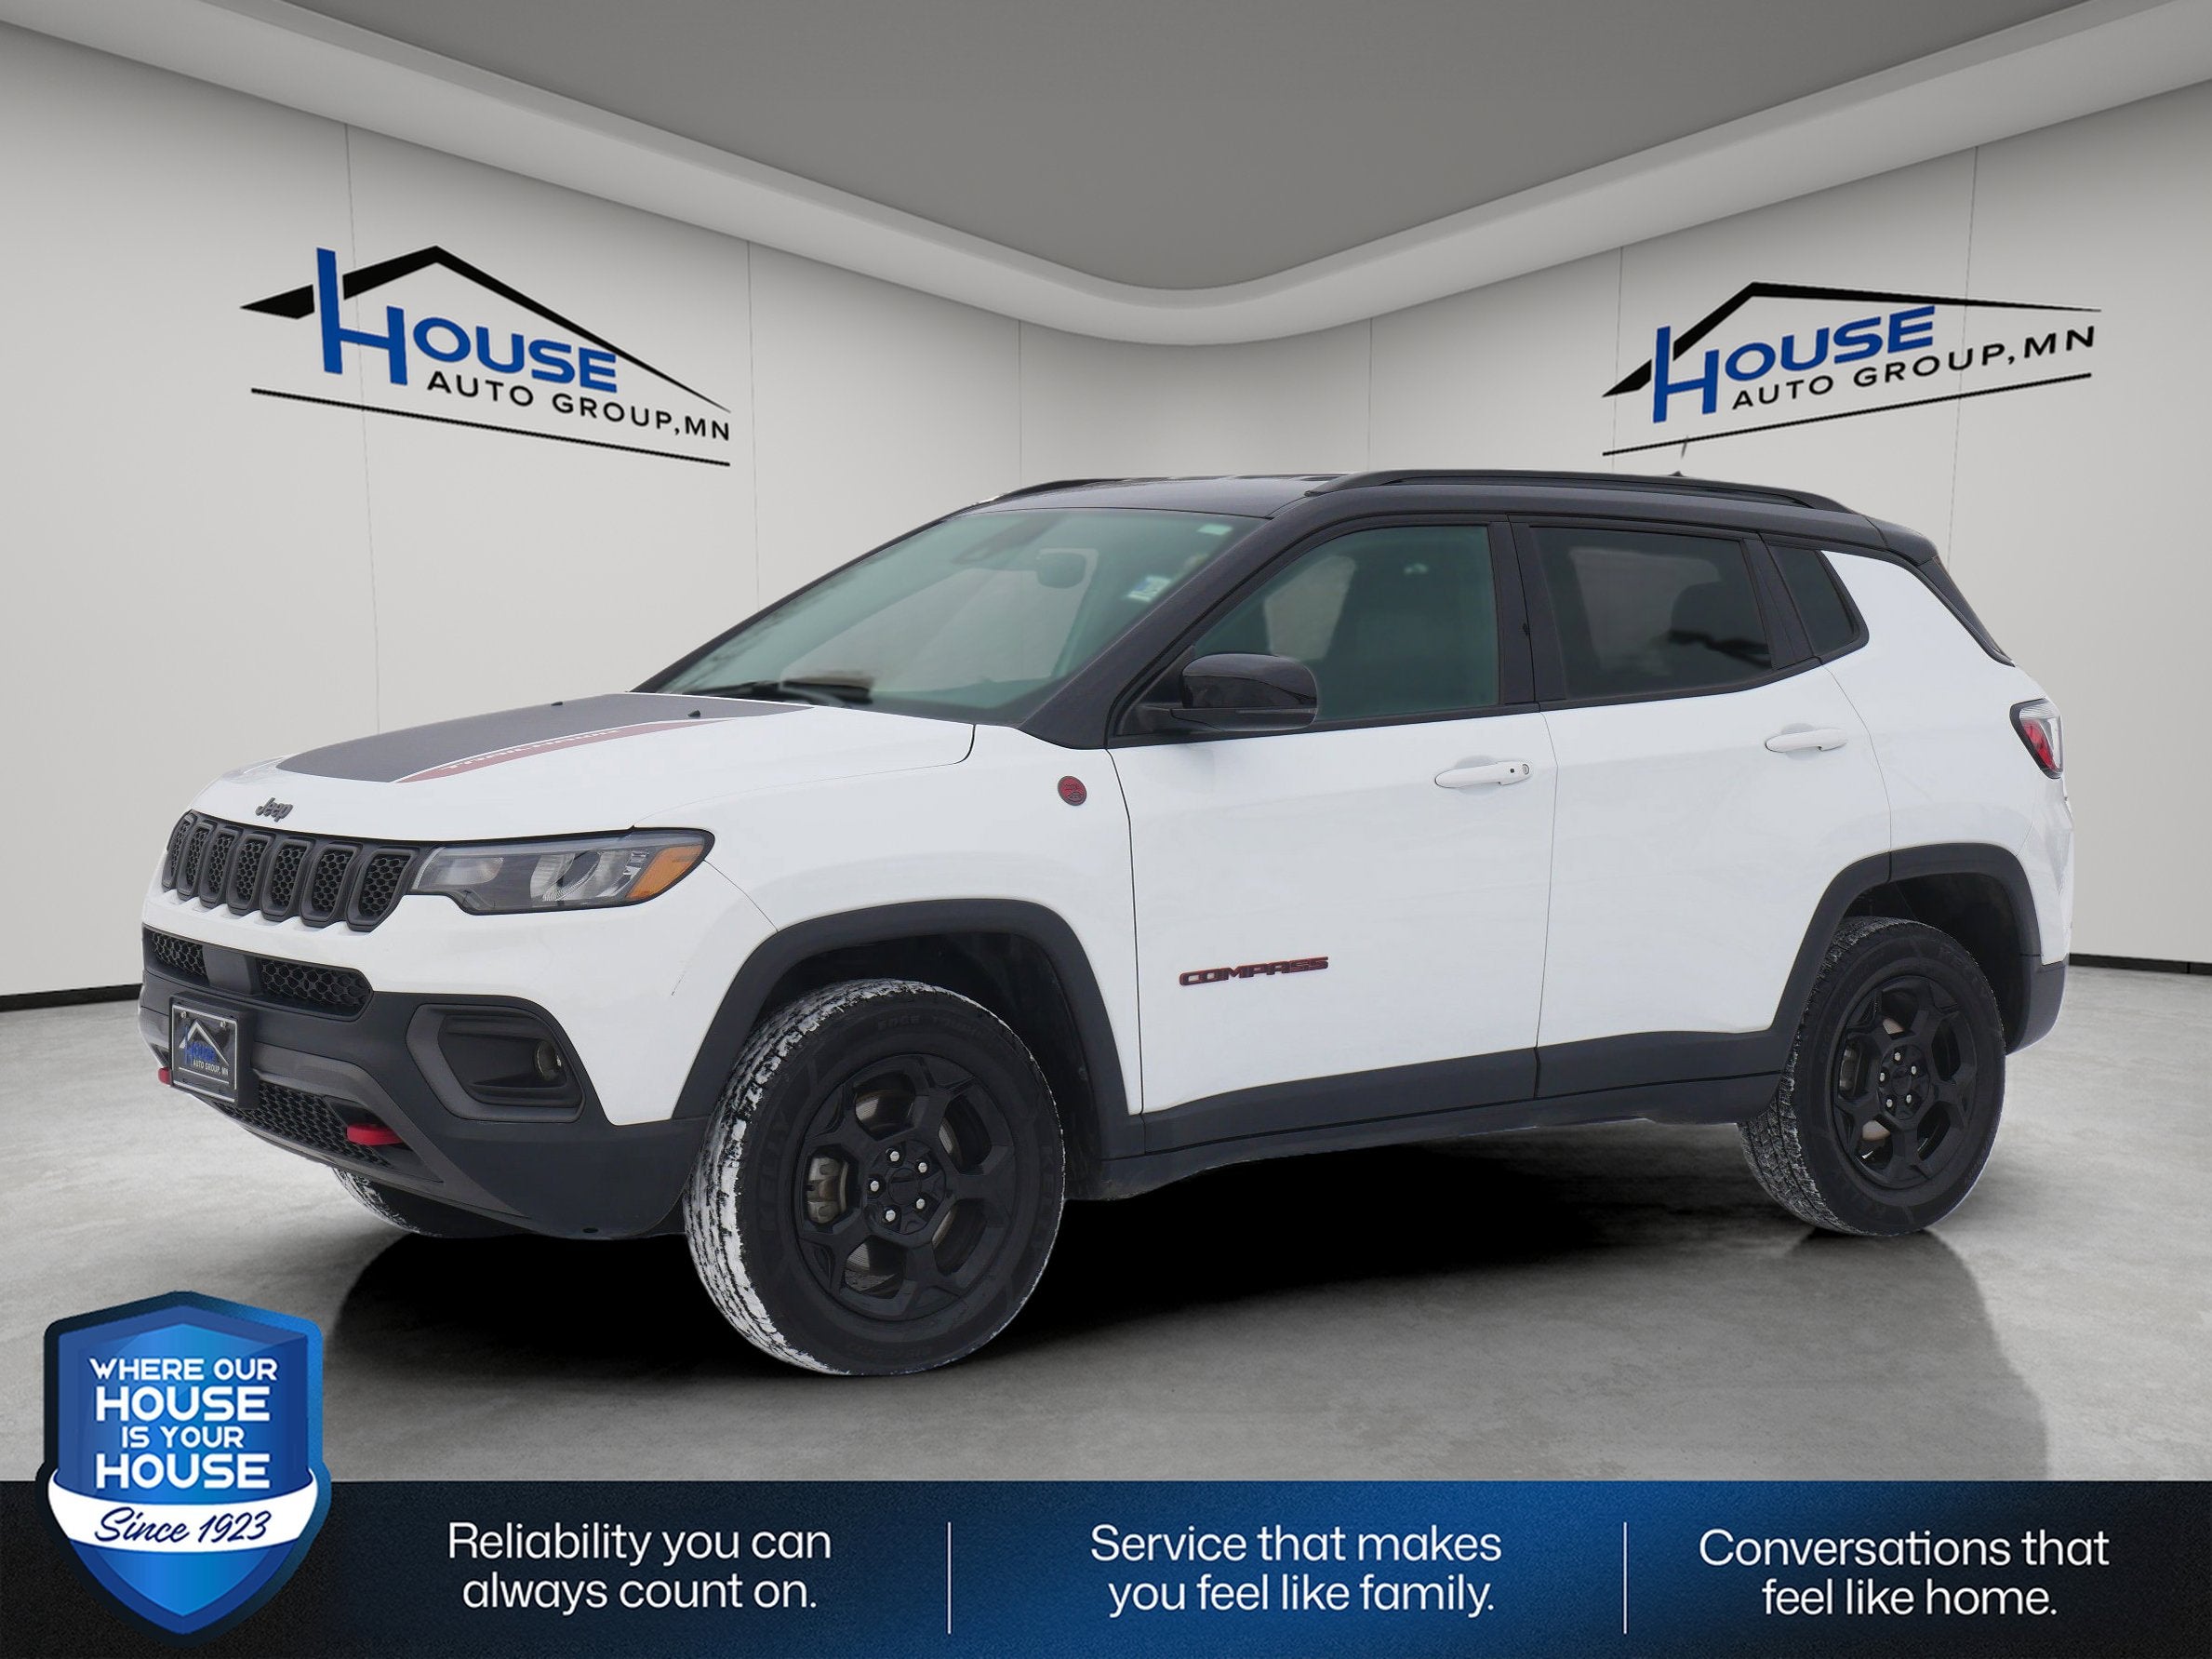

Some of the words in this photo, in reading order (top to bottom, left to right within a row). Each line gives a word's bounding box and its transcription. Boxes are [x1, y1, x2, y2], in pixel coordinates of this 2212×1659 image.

[316, 248, 618, 394] HOUSE
[1652, 304, 1937, 423] HOUSE
[427, 370, 535, 407] AUTO
[1732, 375, 1834, 410] AUTO
[255, 797, 293, 823] Jeep
[1179, 957, 1328, 986] COMPASS
